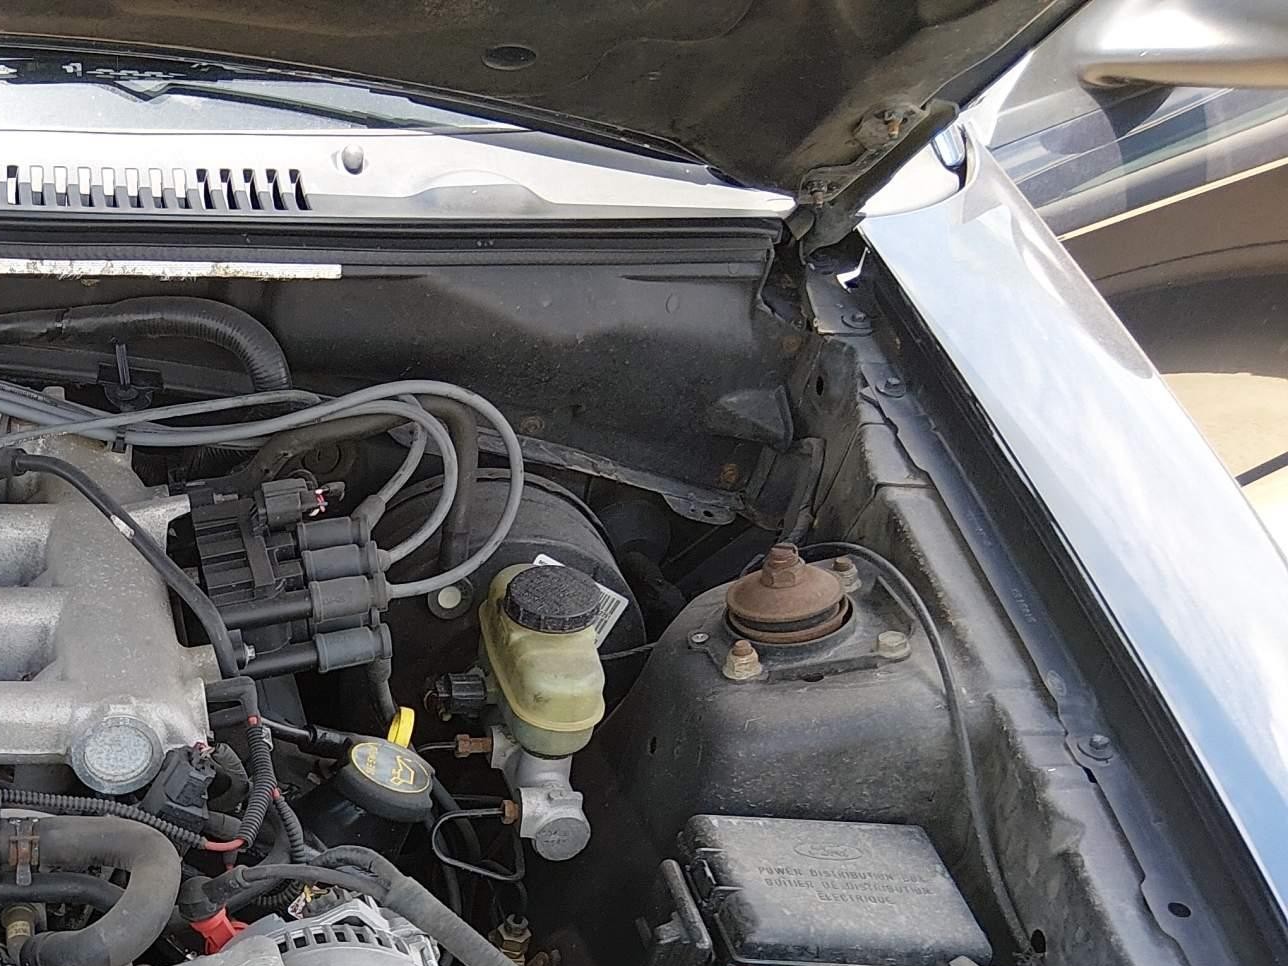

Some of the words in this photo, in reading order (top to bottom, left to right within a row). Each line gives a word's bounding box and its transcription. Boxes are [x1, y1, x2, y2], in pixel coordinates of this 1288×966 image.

[758, 866, 802, 876] POWER
[809, 869, 894, 881] DISTRIBUTION
[822, 881, 839, 890] DE
[846, 882, 934, 895] DISTRIBUTION
